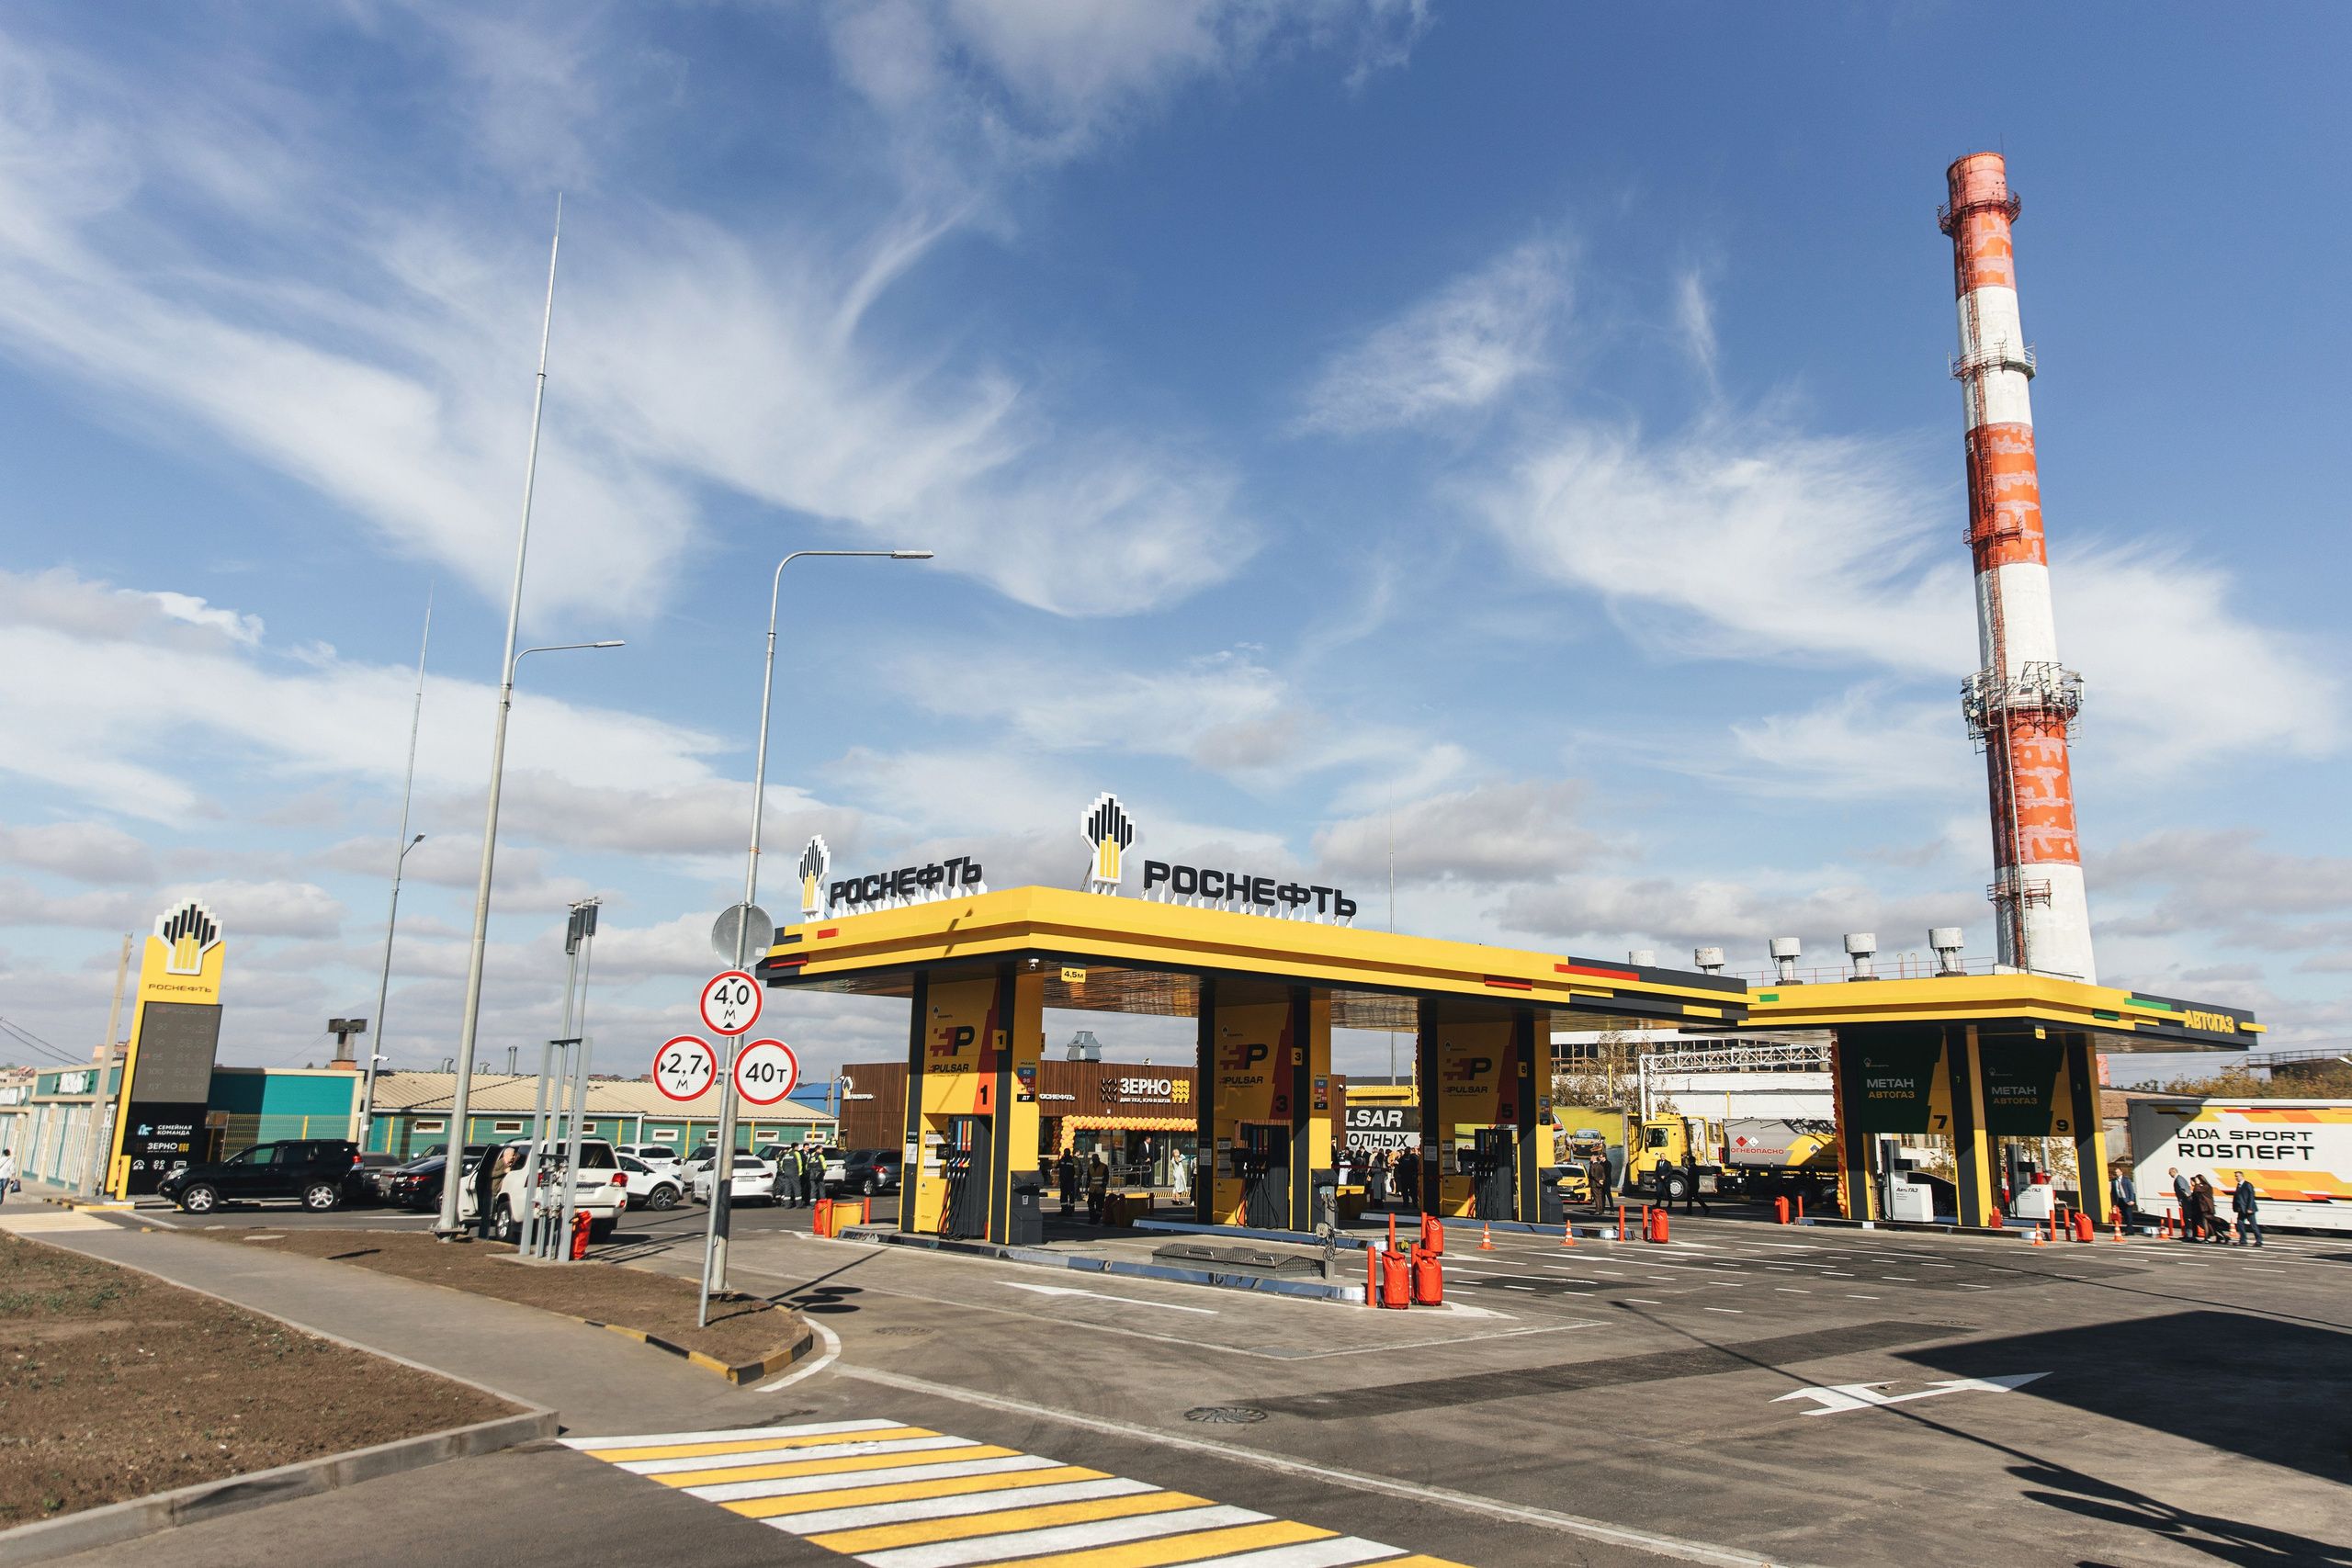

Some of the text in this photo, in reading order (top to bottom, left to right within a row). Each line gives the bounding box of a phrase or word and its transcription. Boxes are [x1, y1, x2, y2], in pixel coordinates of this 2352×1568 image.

[830, 856, 982, 908] РОСНЕФТЬ
[1144, 860, 1357, 917] РОСНЕФТЬ
[148, 984, 212, 993] РОСНЕФТЬ
[714, 984, 751, 1008] 4,0
[2185, 1010, 2235, 1033] АВТОГАЗ
[998, 1034, 1003, 1045] 1
[1295, 1052, 1302, 1061] 3
[667, 1053, 704, 1076] 2,7
[933, 1063, 969, 1073] PULSAR
[1119, 1077, 1172, 1096] ЗЕРНО
[1225, 1076, 1263, 1085] PULSAR
[1866, 1078, 1915, 1089] МЕТАН
[980, 1085, 988, 1105] 1
[1449, 1086, 1488, 1094] PULSAR
[1868, 1090, 1916, 1099] АВТОГАЗ
[1991, 1086, 2037, 1095] МЕТАН
[1275, 1095, 1288, 1112] 3
[1501, 1103, 1514, 1119] 5
[1346, 1110, 1403, 1128] LSAR
[1933, 1114, 1948, 1130] 7
[2056, 1119, 2069, 1132] 9
[1346, 1133, 1408, 1147] ОЛНЫХ
[2175, 1128, 2313, 1142] LADA SPORT
[147, 1142, 178, 1150] ЗЕРНО
